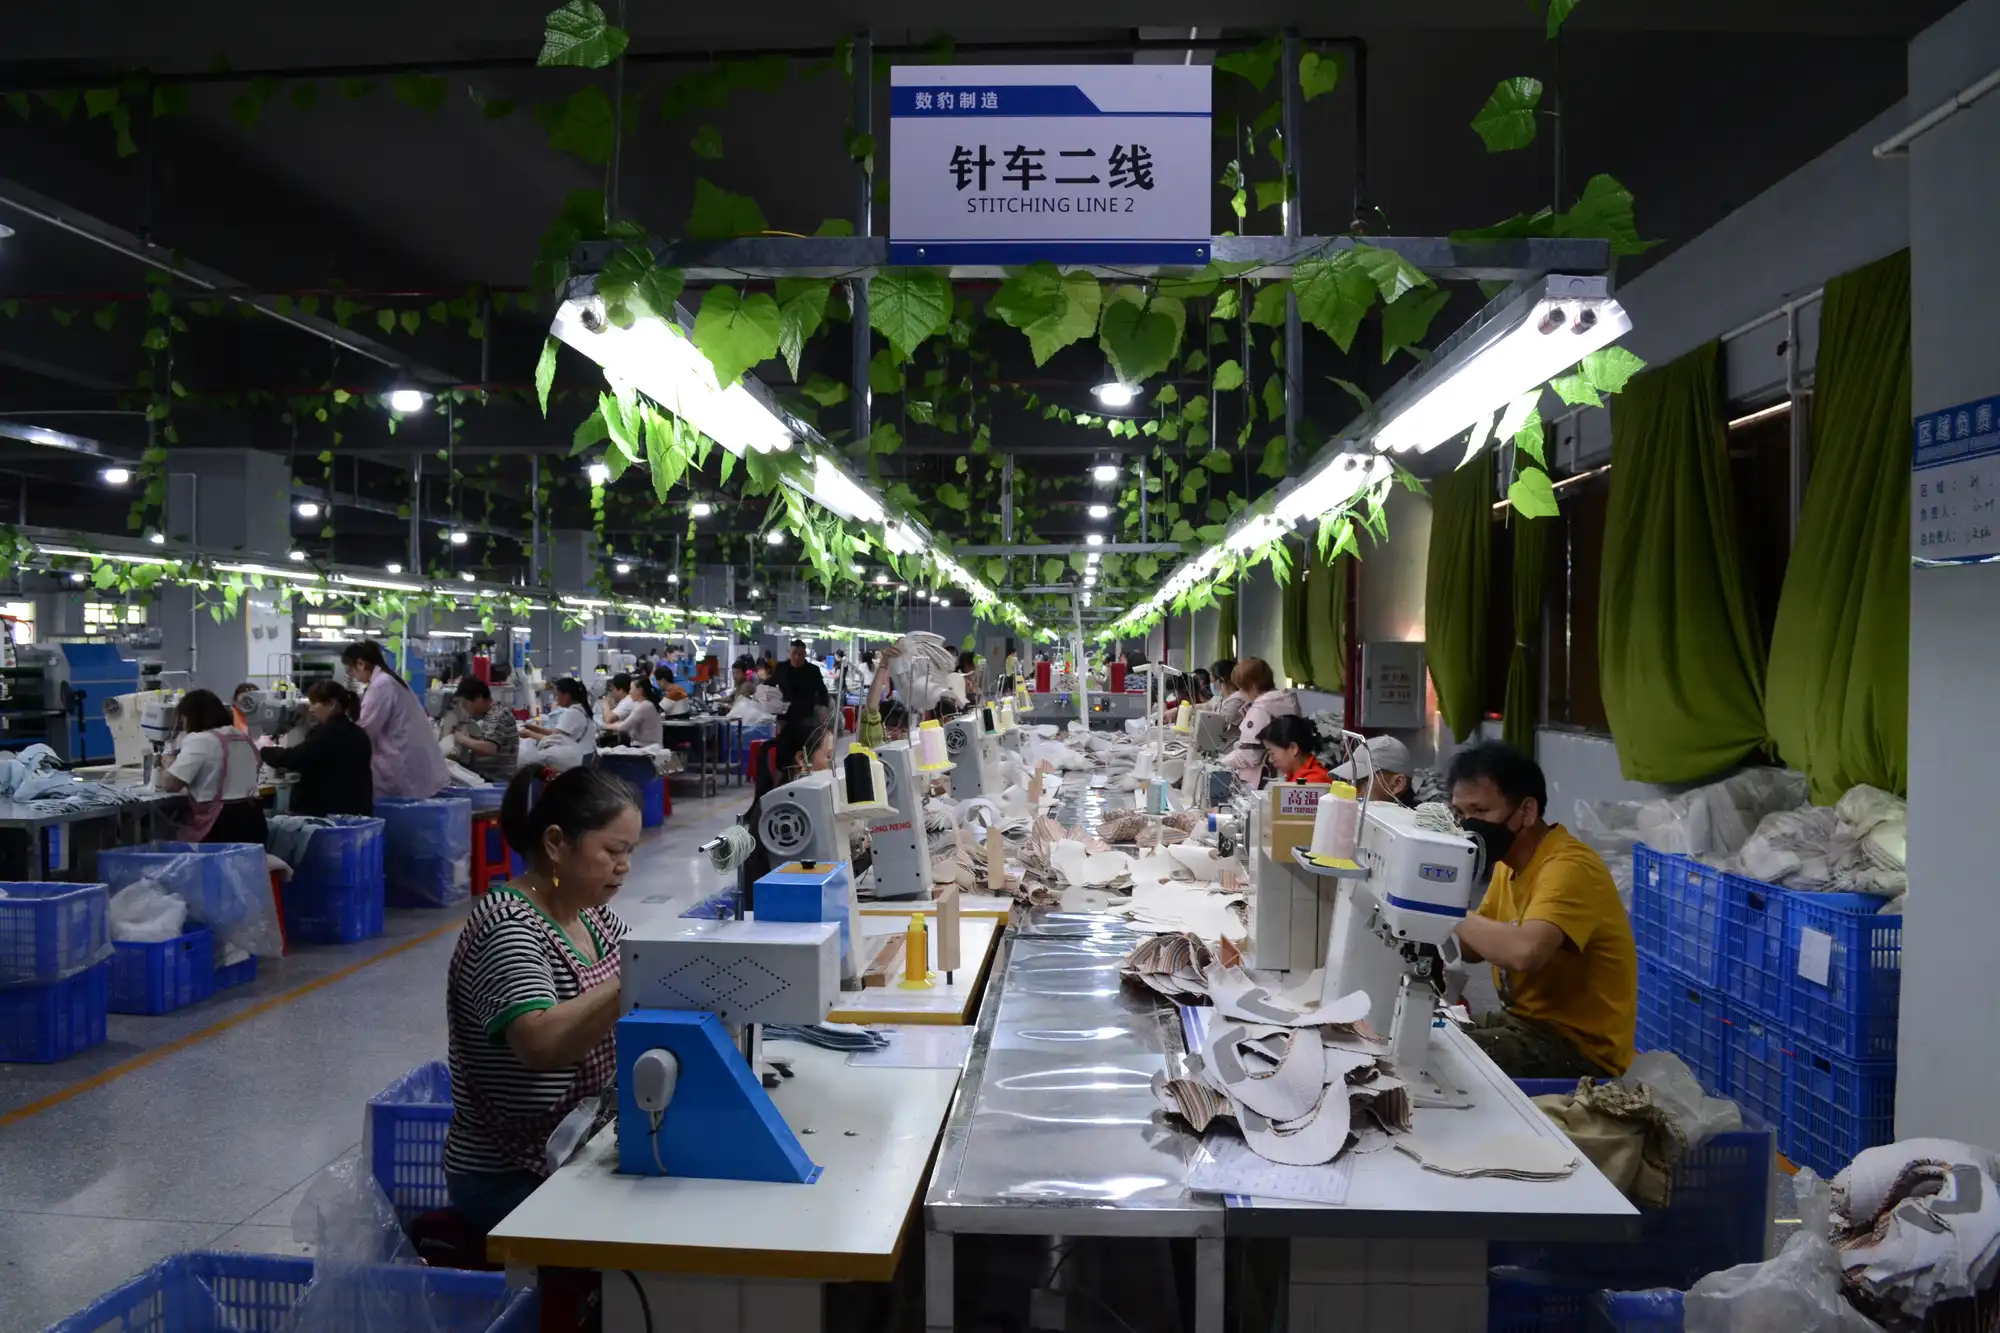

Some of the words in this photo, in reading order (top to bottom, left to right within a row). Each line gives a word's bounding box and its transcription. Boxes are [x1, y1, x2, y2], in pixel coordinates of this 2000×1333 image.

[915, 91, 999, 111] 数豹制造
[949, 144, 1155, 192] 针车二线
[967, 197, 1071, 213] STITCHING
[1077, 197, 1118, 213] LINE
[1124, 197, 1135, 213] 2
[1917, 403, 2000, 447] 区域负责
[1288, 789, 1319, 806] 高温
[1423, 866, 1455, 879] TTY
